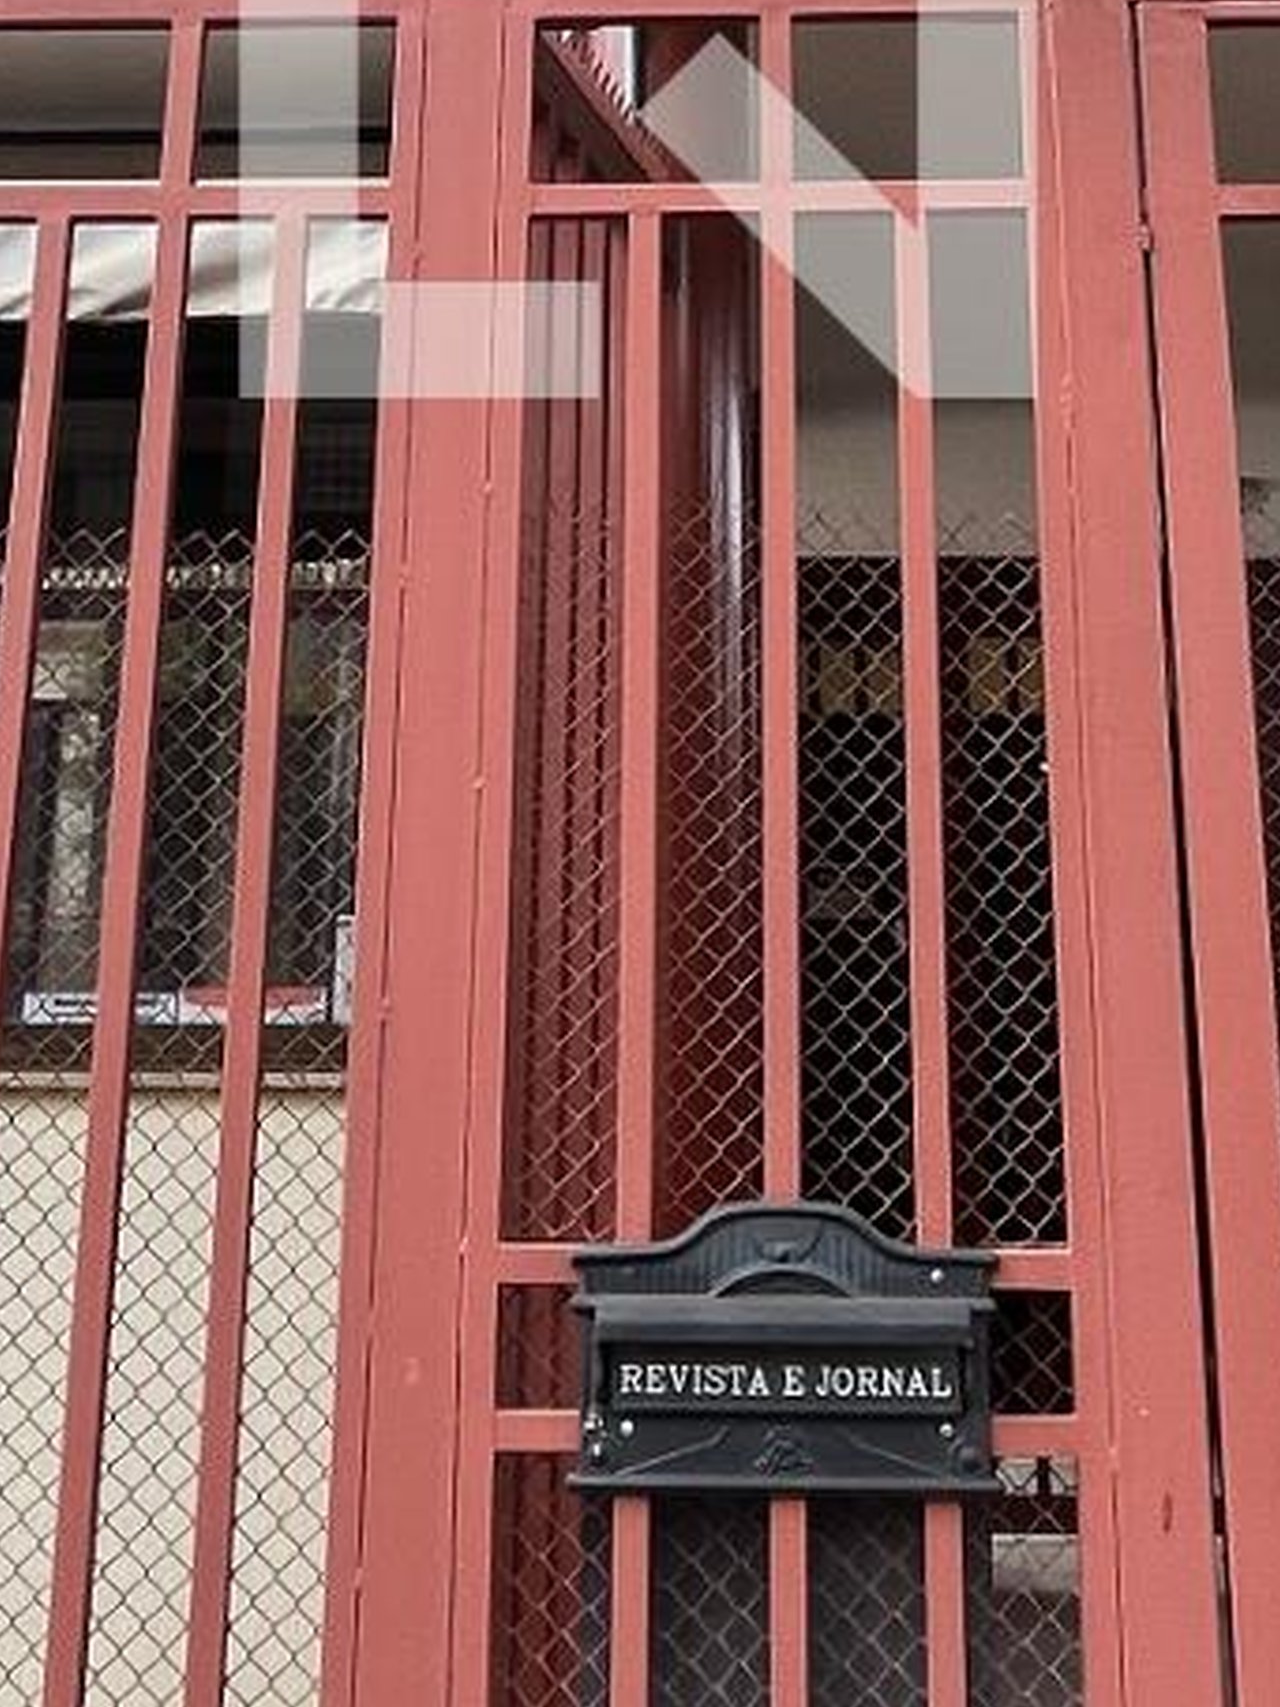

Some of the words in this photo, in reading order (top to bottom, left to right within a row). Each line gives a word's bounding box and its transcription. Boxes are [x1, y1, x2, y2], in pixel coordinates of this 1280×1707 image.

[620, 1364, 770, 1396] REVISTA
[782, 1367, 805, 1397] E
[815, 1367, 952, 1399] JORNAL
